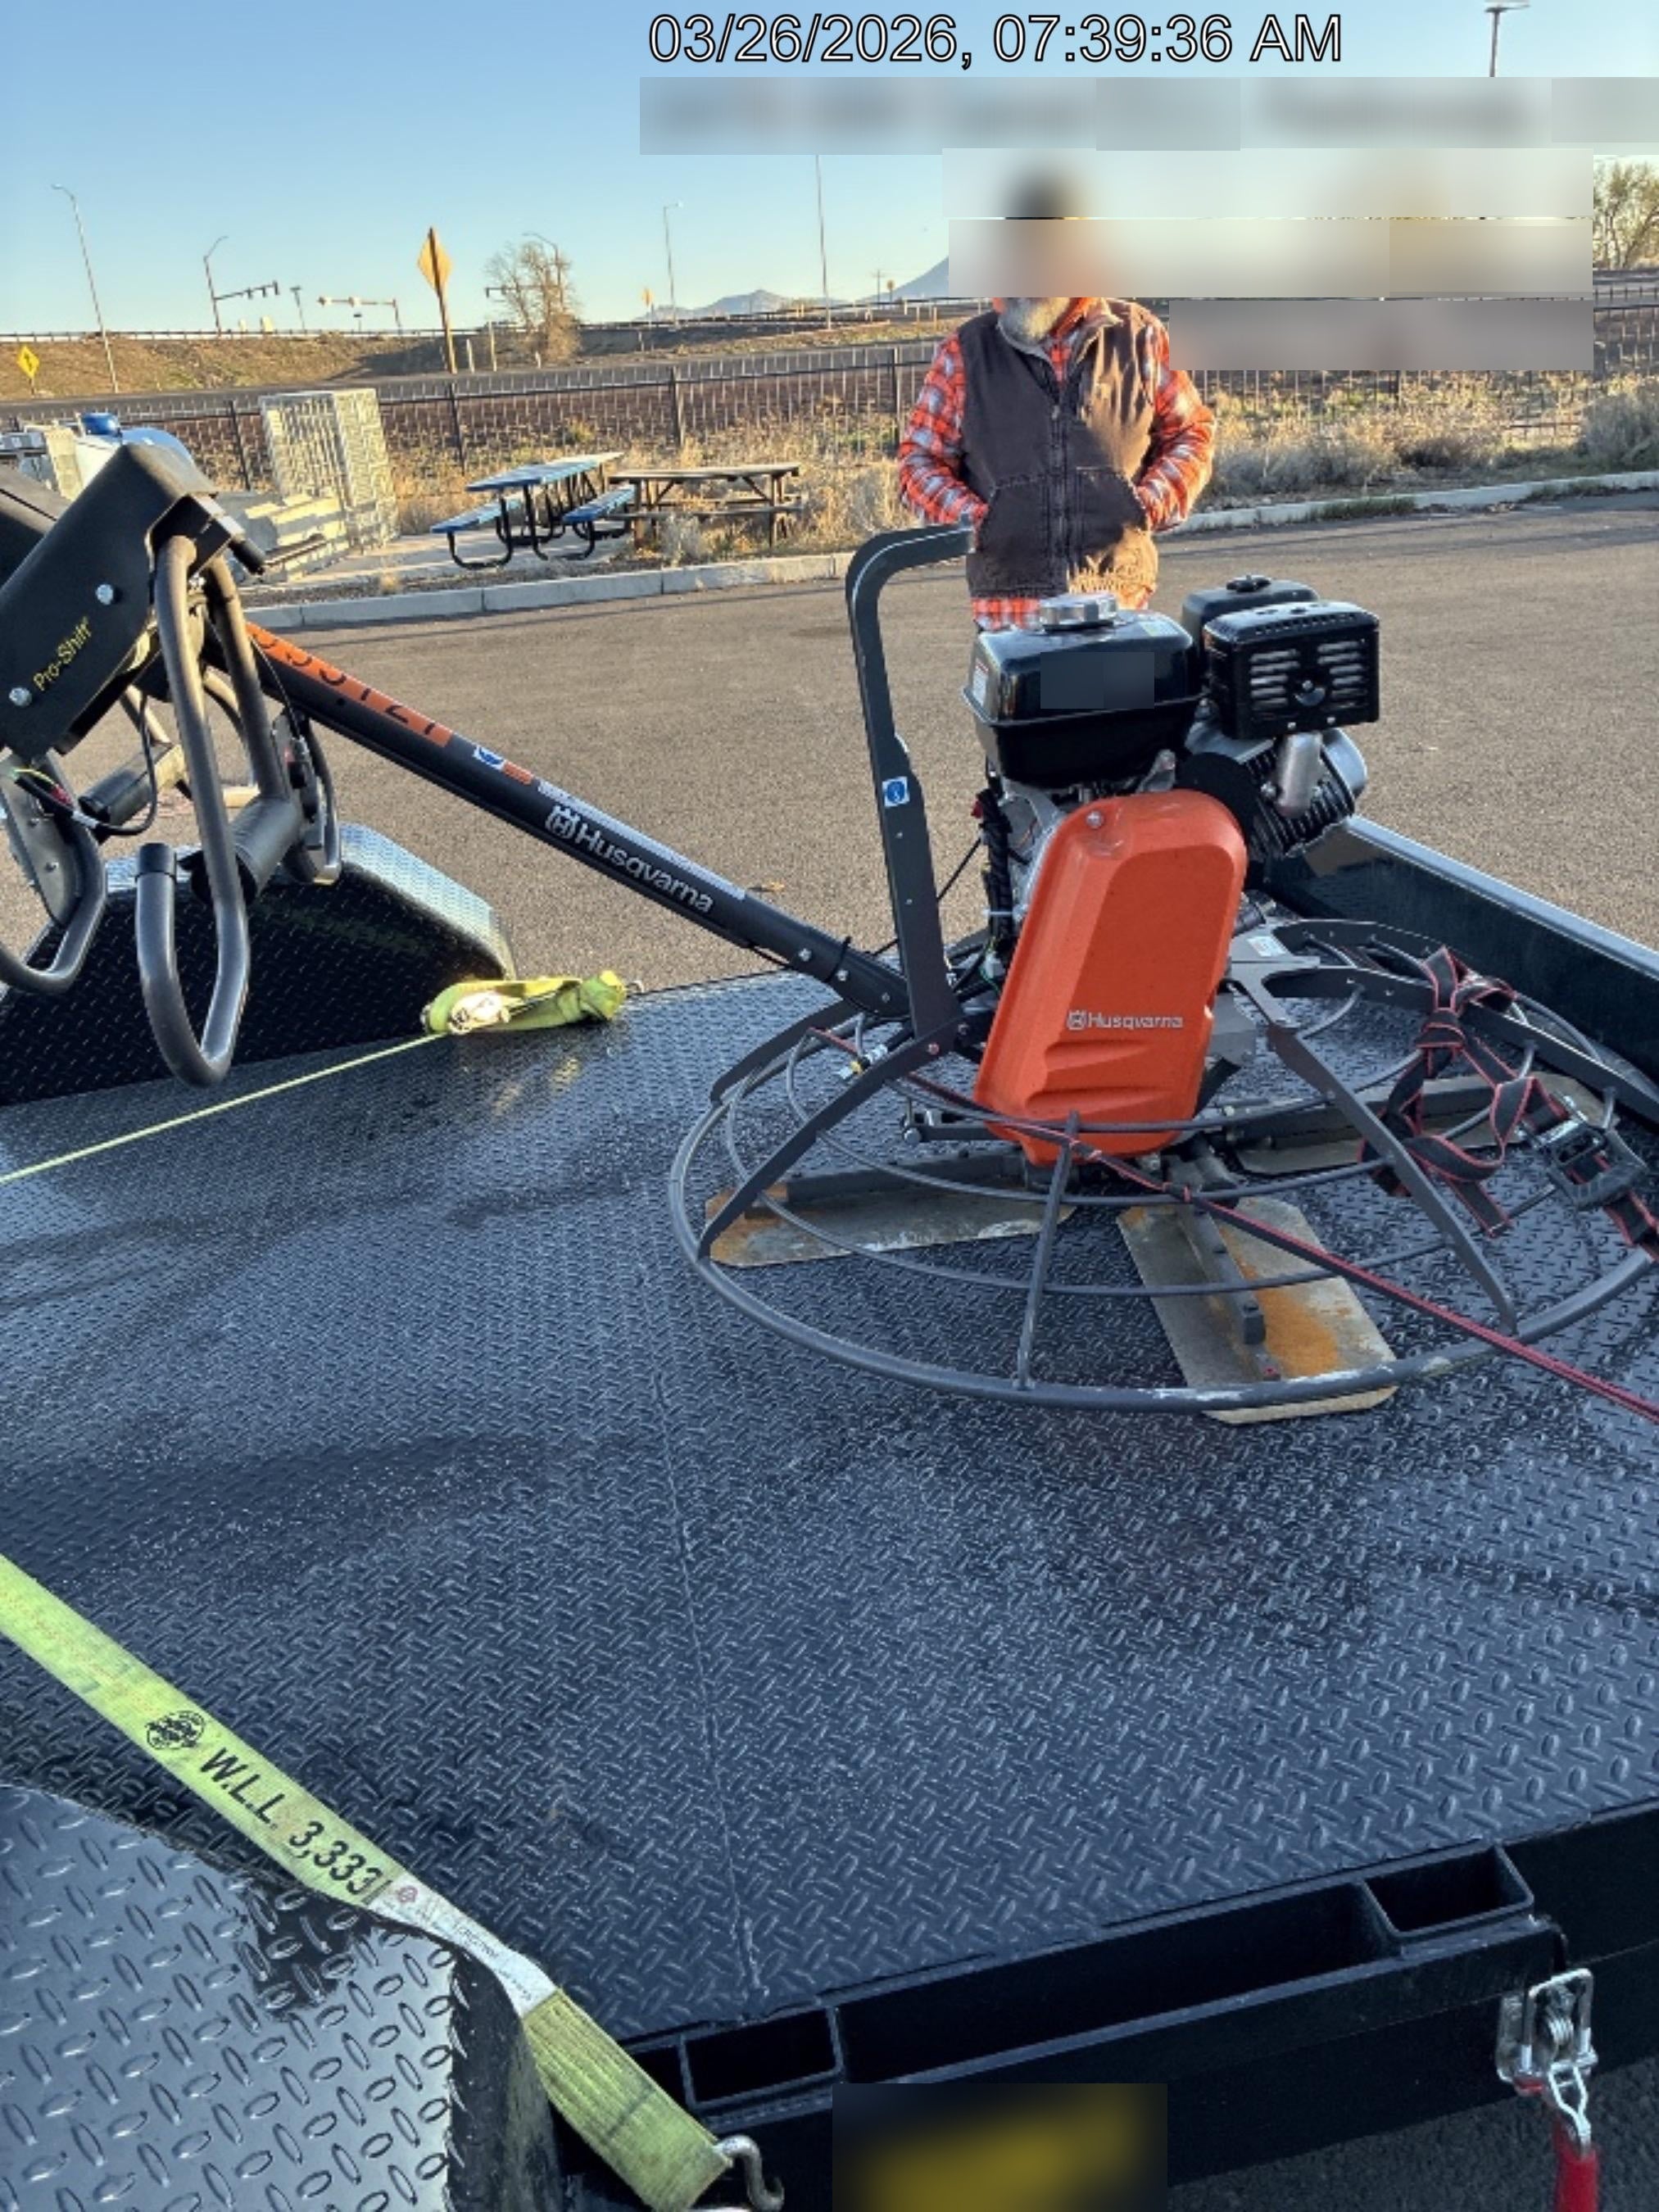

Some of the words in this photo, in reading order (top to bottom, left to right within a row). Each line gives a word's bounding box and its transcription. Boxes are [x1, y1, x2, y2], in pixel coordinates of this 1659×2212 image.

[34, 616, 91, 691] Pro-Shift
[575, 823, 714, 913] Husqvarna
[1088, 1011, 1183, 1030] Husqvarna
[201, 1747, 285, 1829] W.L.L.
[289, 1820, 383, 1895] 3,333
